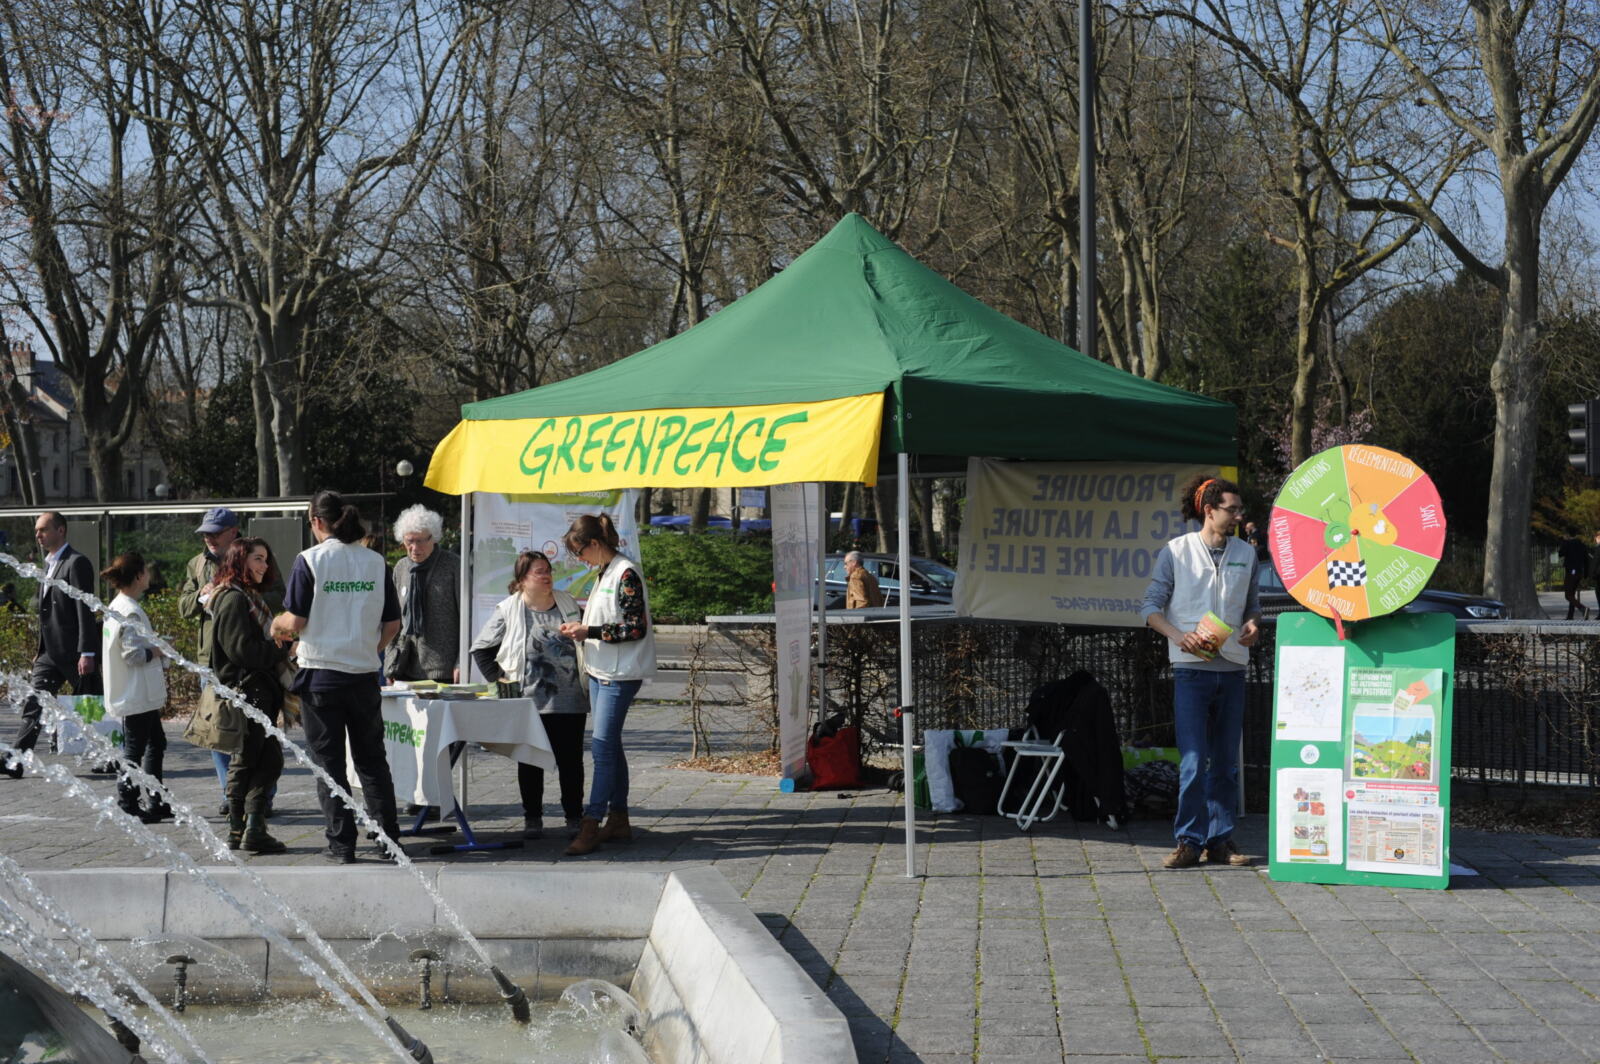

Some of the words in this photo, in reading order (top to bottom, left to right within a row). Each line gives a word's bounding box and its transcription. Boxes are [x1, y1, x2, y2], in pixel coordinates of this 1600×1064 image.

[519, 410, 808, 489] GREENPEACE
[1273, 515, 1297, 581] ENVIRONNEMENT
[323, 581, 375, 593] GREENPEACE
[1373, 556, 1409, 590] PESTICIDE
[1400, 566, 1427, 596] COURSE
[1306, 588, 1356, 617] PRODUCTION
